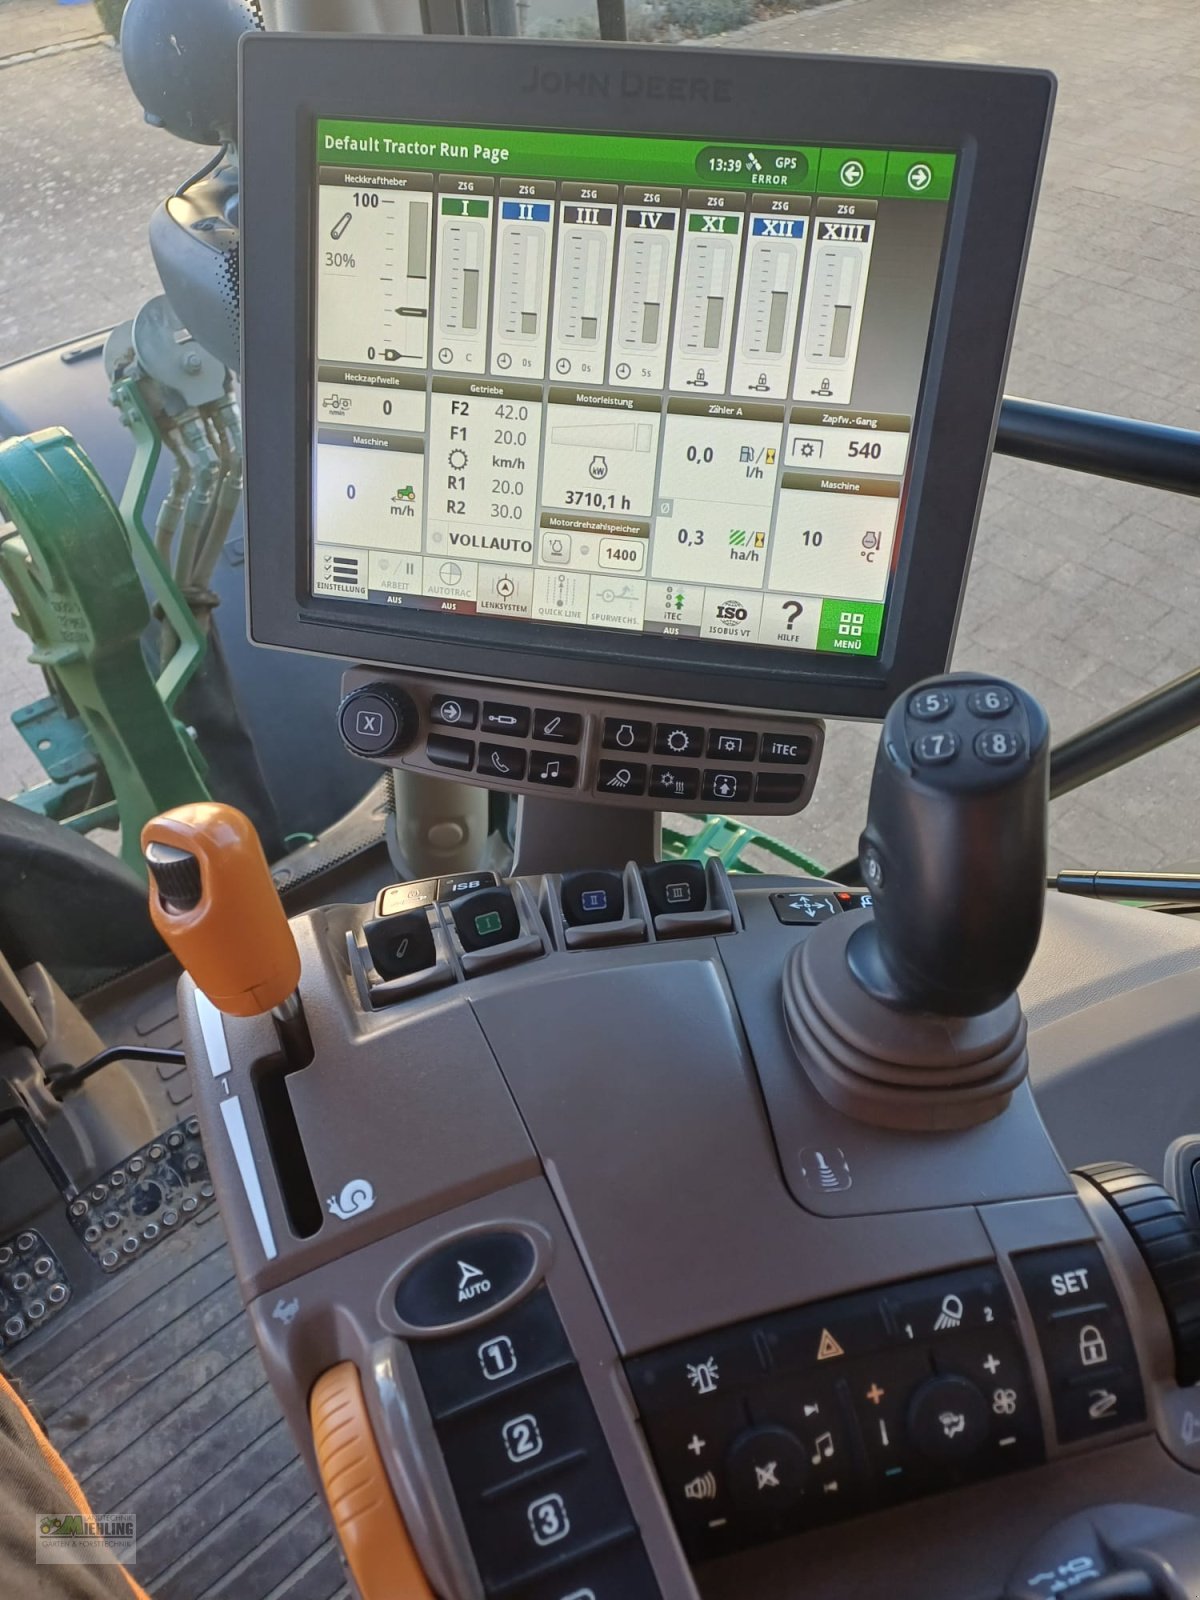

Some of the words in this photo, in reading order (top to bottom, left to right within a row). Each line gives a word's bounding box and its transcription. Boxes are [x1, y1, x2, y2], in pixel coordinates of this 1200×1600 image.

[520, 65, 609, 97] JOHN
[621, 70, 734, 103] DEERE
[324, 134, 380, 153] Default
[383, 138, 436, 156] Tractor
[440, 142, 468, 158] Run
[473, 144, 510, 164] Page
[708, 158, 742, 172] 13:39
[775, 156, 797, 170] GPS
[344, 174, 408, 187] Heckkraftheber
[458, 180, 474, 192] ZSG
[752, 174, 788, 186] ERROR
[518, 184, 536, 196] ZSG
[580, 188, 598, 199] ZSG
[644, 193, 660, 203] ZSG
[352, 192, 380, 208] 100
[460, 200, 470, 216] I
[707, 196, 724, 207] ZSG
[772, 200, 789, 211] ZSG
[518, 204, 534, 220] II
[576, 208, 600, 224] III
[837, 204, 856, 216] ZSG
[638, 211, 662, 229] IV
[700, 216, 726, 233] XI
[761, 219, 794, 238] XII
[822, 224, 864, 242] XIII
[324, 252, 356, 268] 30%
[367, 346, 376, 360] 0
[344, 372, 400, 386] Heckzapfwelle
[470, 384, 504, 396] Getriebe
[382, 400, 392, 416] 0
[576, 394, 634, 408] Motorleistung
[451, 400, 470, 416] F2
[494, 404, 529, 421] 42.0
[708, 404, 734, 416] Zähler
[736, 407, 743, 416] A
[822, 414, 878, 428] Zapfw.-Gang
[352, 436, 389, 447] Maschine
[450, 426, 468, 442] F1
[494, 430, 528, 446] 20.0
[686, 446, 714, 464] 0,0
[848, 440, 882, 460] 540
[492, 455, 526, 470] km/h
[592, 466, 605, 476] kW
[346, 484, 356, 500] 0
[448, 476, 466, 490] R1
[492, 480, 524, 496] 20.0
[820, 480, 860, 492] Maschine
[564, 490, 616, 510] 3710,1
[622, 495, 631, 510] h
[390, 505, 415, 517] m/h
[446, 500, 466, 515] R2
[490, 504, 523, 520] 30.0
[549, 517, 641, 535] Motordrehzahlspeicher
[449, 532, 532, 553] VOLLAUTO
[678, 528, 704, 546] 0,3
[802, 530, 824, 548] 10
[606, 548, 638, 562] 1400
[730, 549, 760, 562] ha/h
[860, 551, 875, 563] °C
[316, 582, 366, 594] EINSTELLUNG
[381, 580, 410, 590] ARBEIT
[428, 585, 472, 598] AUTOTRAC
[387, 596, 403, 604] AUS
[441, 602, 457, 610] AUS
[481, 601, 528, 613] LENKSYSTEM
[538, 608, 563, 618] QUICK
[564, 610, 582, 619] LINE
[664, 612, 682, 622] iTEC
[716, 606, 748, 622] ISO
[663, 626, 680, 636] AUS
[709, 626, 738, 637] ISOBUS
[740, 628, 752, 638] VT
[777, 633, 800, 643] HILFE
[834, 638, 862, 650] MENÜ
[926, 694, 940, 712] 5
[985, 692, 1001, 709] 6
[363, 716, 376, 732] X
[772, 742, 798, 757] iTEC
[931, 736, 946, 755] 7
[992, 734, 1007, 753] 8
[452, 878, 481, 893] ISB
[1051, 1268, 1090, 1297] SET
[458, 1280, 492, 1302] AUTO
[983, 1306, 995, 1323] 2
[904, 1324, 914, 1340] 1
[488, 1344, 506, 1371] 1
[512, 1424, 534, 1451] 2
[538, 1504, 560, 1535] 3
